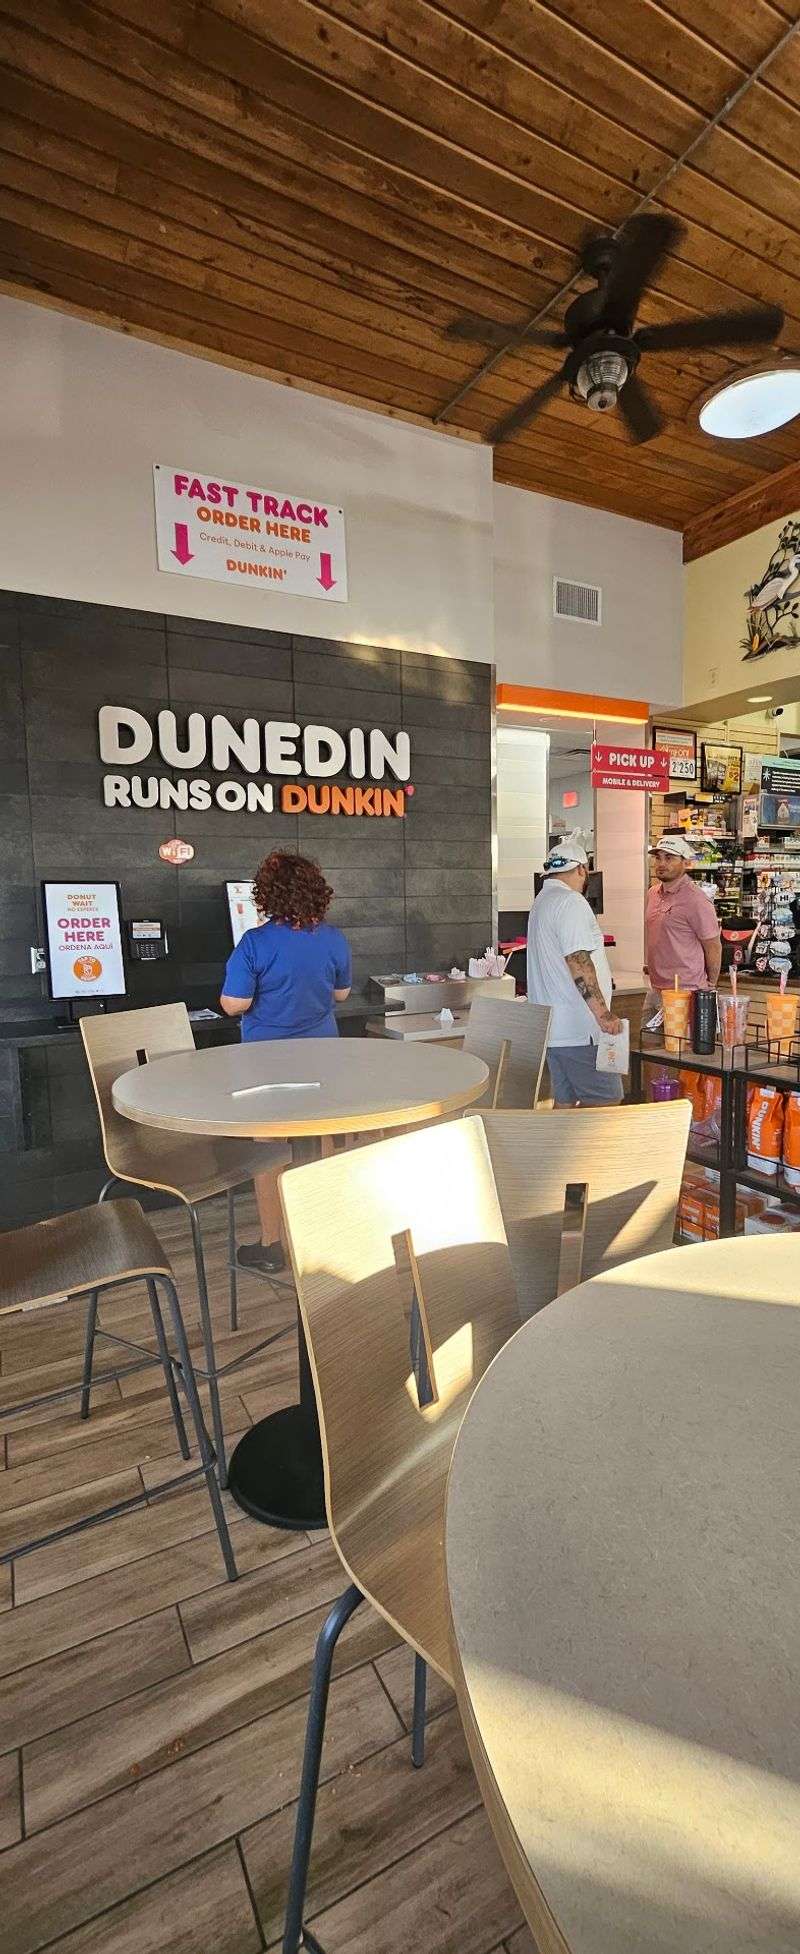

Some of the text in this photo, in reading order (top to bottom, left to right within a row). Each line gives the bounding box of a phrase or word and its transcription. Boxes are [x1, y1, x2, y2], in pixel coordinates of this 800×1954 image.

[174, 474, 329, 528] FAST TRACK
[196, 506, 311, 543] ORDER HERE
[200, 532, 311, 562] Credit, Debit & Apple Pay
[226, 559, 287, 581] DUNKIN'
[98, 705, 411, 782] DUNEDIN
[608, 752, 655, 769] PICK UP
[103, 774, 212, 811] RUNS
[215, 780, 274, 813] ON
[602, 777, 626, 786] MOBILE
[632, 780, 660, 788] DELIVERY
[57, 918, 111, 929] ORDER
[64, 931, 105, 942] HERE
